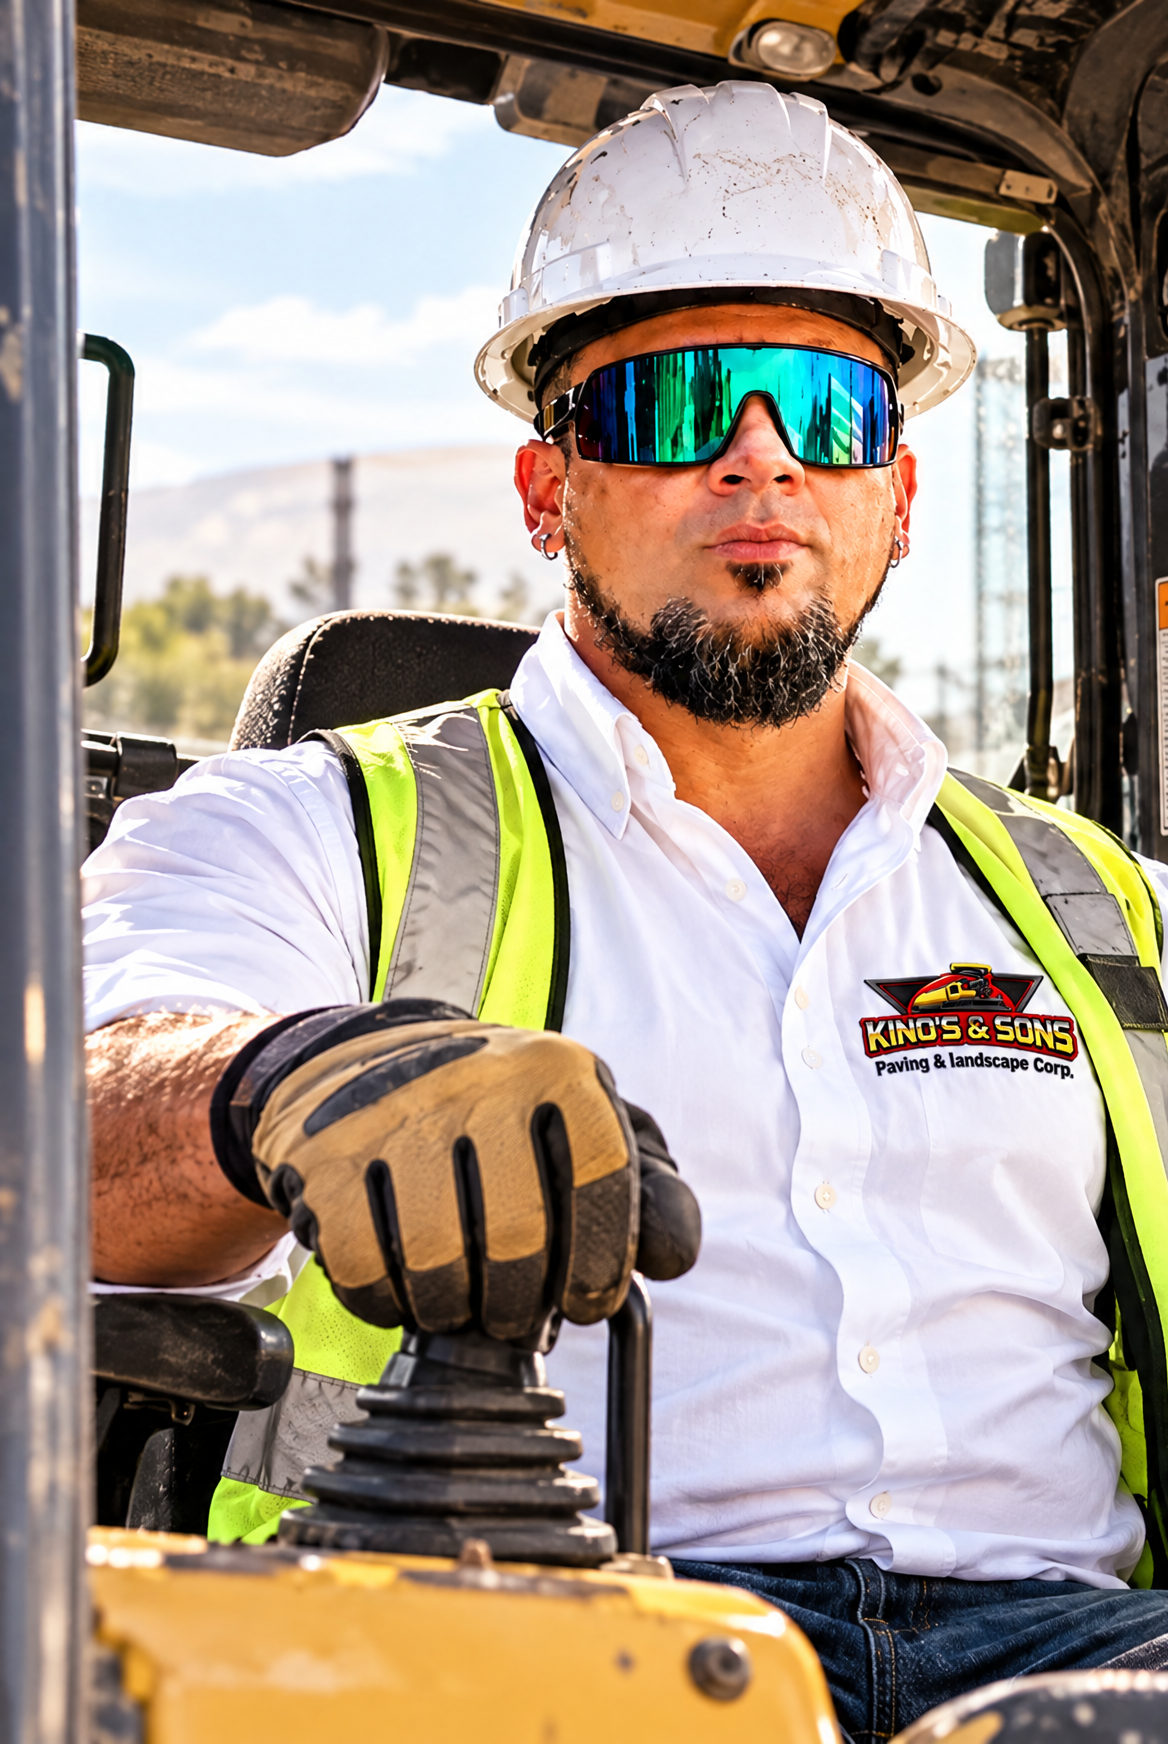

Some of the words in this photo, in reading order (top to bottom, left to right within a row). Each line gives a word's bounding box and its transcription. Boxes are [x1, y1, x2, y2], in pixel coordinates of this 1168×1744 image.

[865, 1016, 961, 1051] KINO'S
[968, 1016, 990, 1040] &
[994, 1016, 1074, 1054] SONS
[875, 1056, 930, 1076] Paving
[934, 1053, 947, 1069] &
[949, 1052, 1029, 1072] landscape
[1033, 1057, 1074, 1079] Corp.
